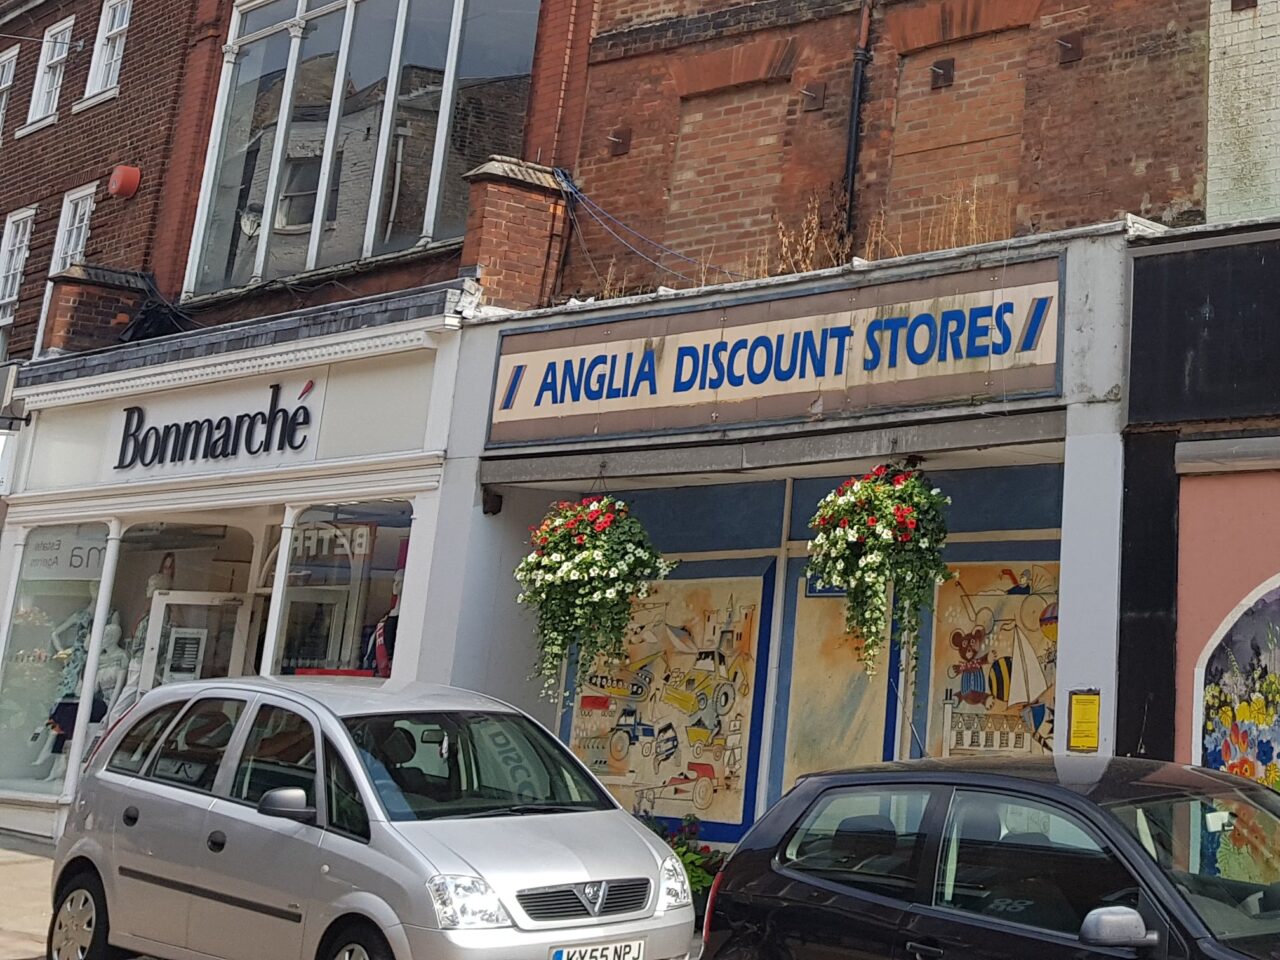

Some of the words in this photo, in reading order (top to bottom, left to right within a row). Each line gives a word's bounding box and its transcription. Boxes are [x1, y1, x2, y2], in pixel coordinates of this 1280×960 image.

[533, 348, 657, 407] ANGLIA
[672, 325, 854, 393] DISCOUNT
[863, 301, 1014, 372] STORES
[113, 380, 314, 470] Bonmarché
